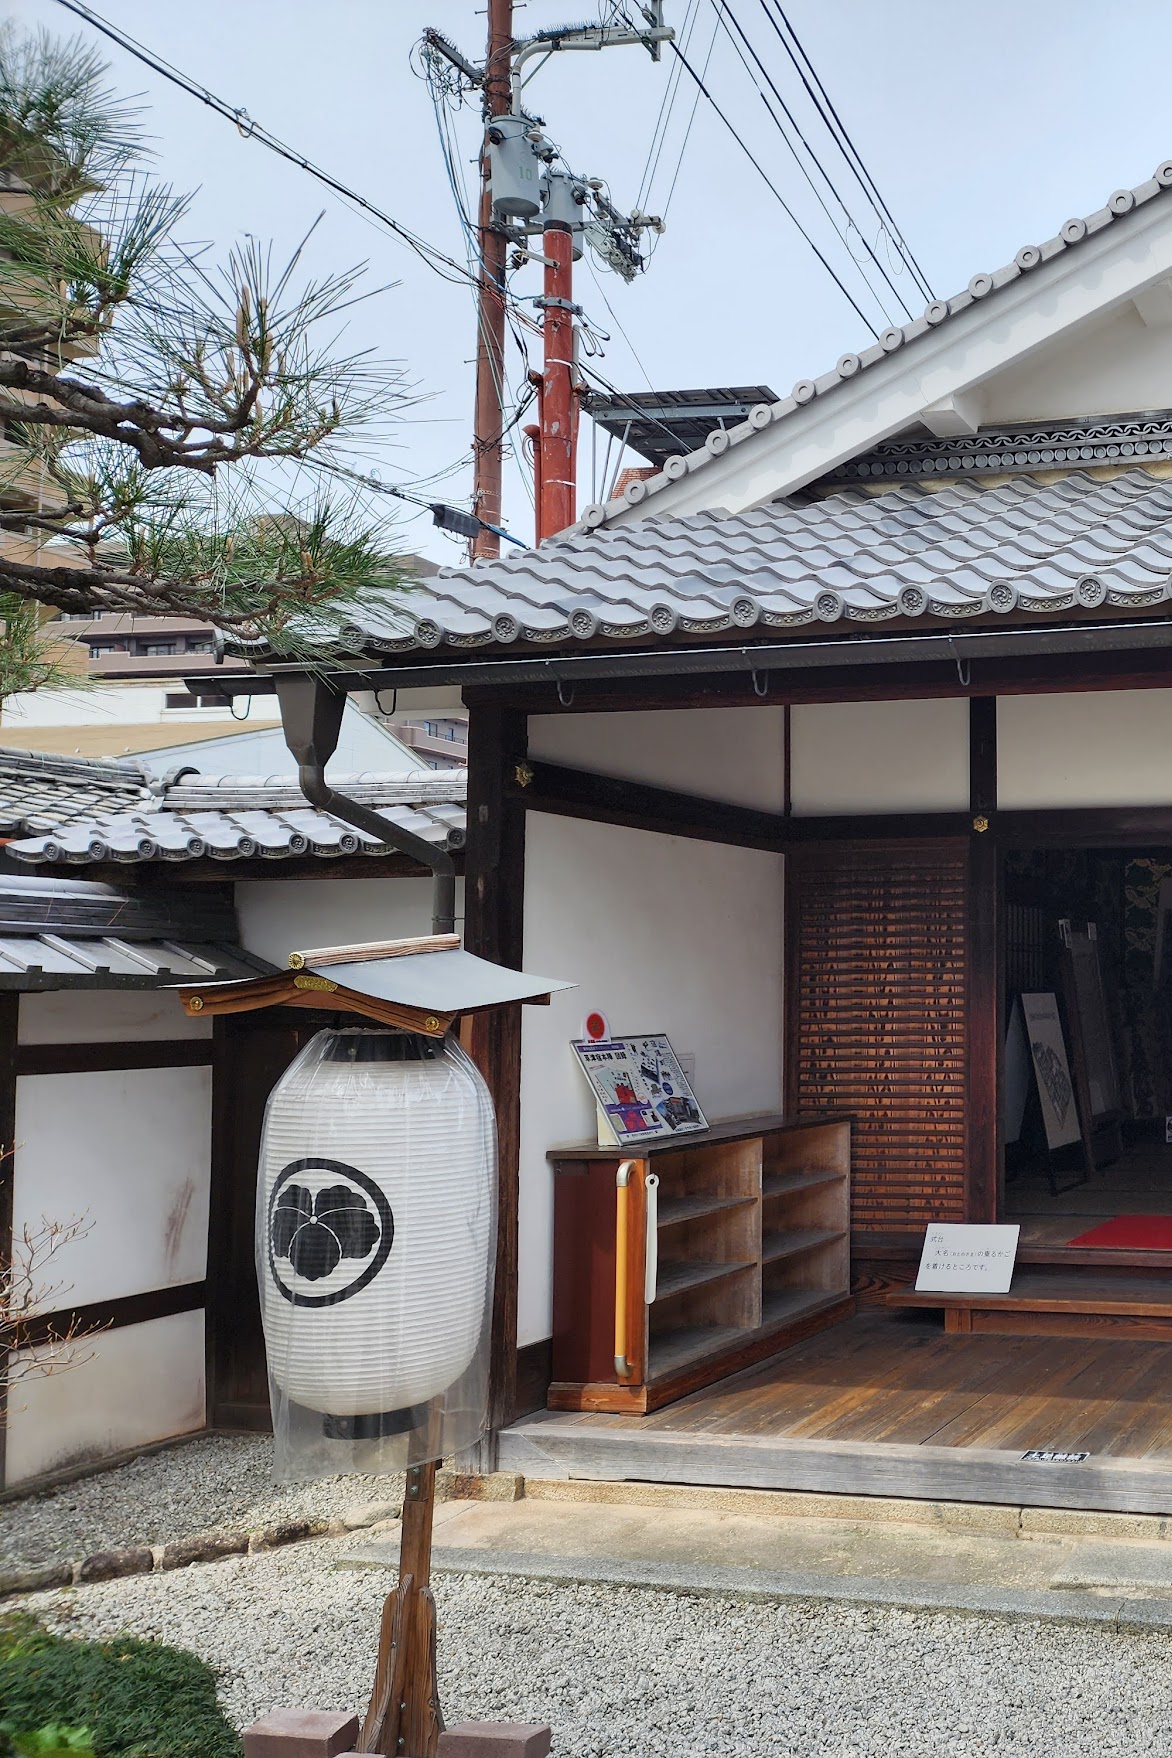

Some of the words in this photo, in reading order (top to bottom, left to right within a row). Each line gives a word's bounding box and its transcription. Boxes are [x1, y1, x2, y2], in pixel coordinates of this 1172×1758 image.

[930, 1235, 944, 1243] 式台
[926, 1263, 988, 1271] を着けるところです。
